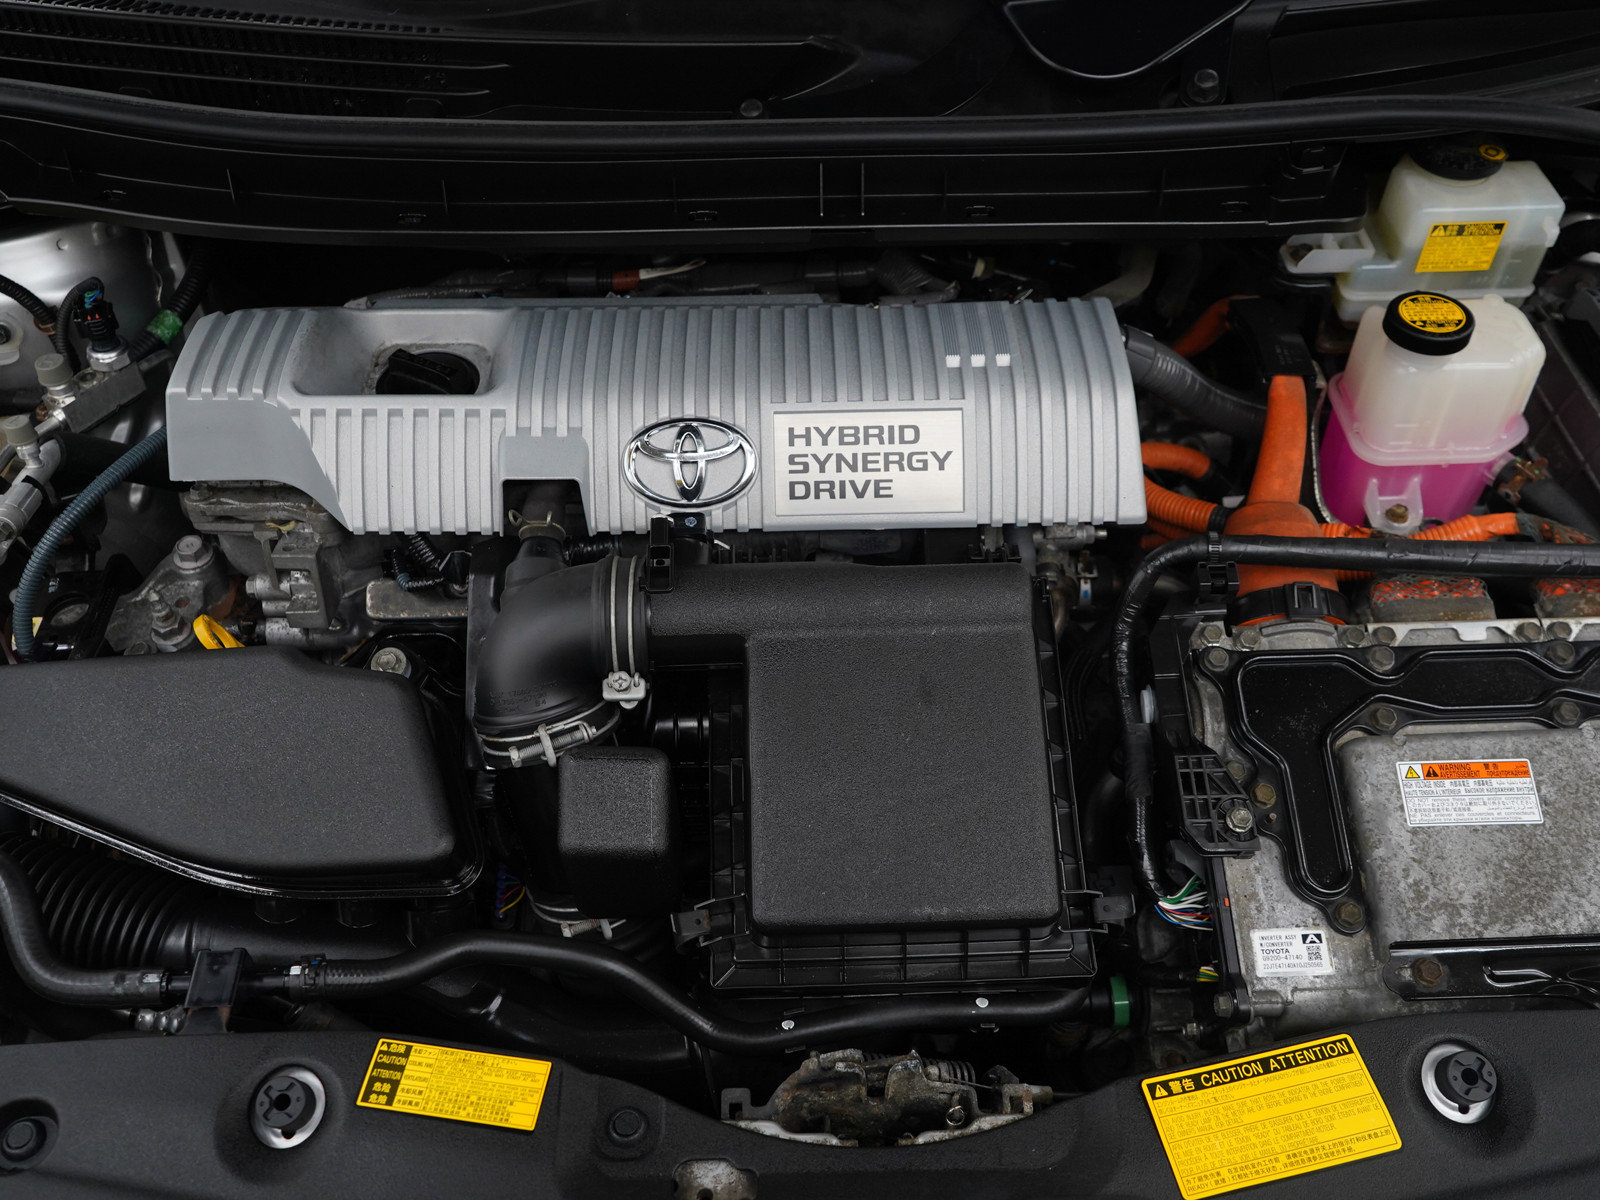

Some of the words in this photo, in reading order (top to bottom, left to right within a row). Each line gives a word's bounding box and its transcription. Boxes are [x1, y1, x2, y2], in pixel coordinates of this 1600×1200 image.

[788, 425, 920, 446] HYBRID
[788, 451, 953, 474] SYNERGY
[788, 479, 893, 500] DRIVE
[1440, 770, 1481, 778] AVERTISSEMENT
[376, 1054, 407, 1066] CAUTION
[1200, 1061, 1264, 1088] CAUTION
[1269, 1040, 1349, 1071] ATTENTION
[371, 1068, 402, 1081] ATTENTION
[1169, 1078, 1195, 1094] 警告
